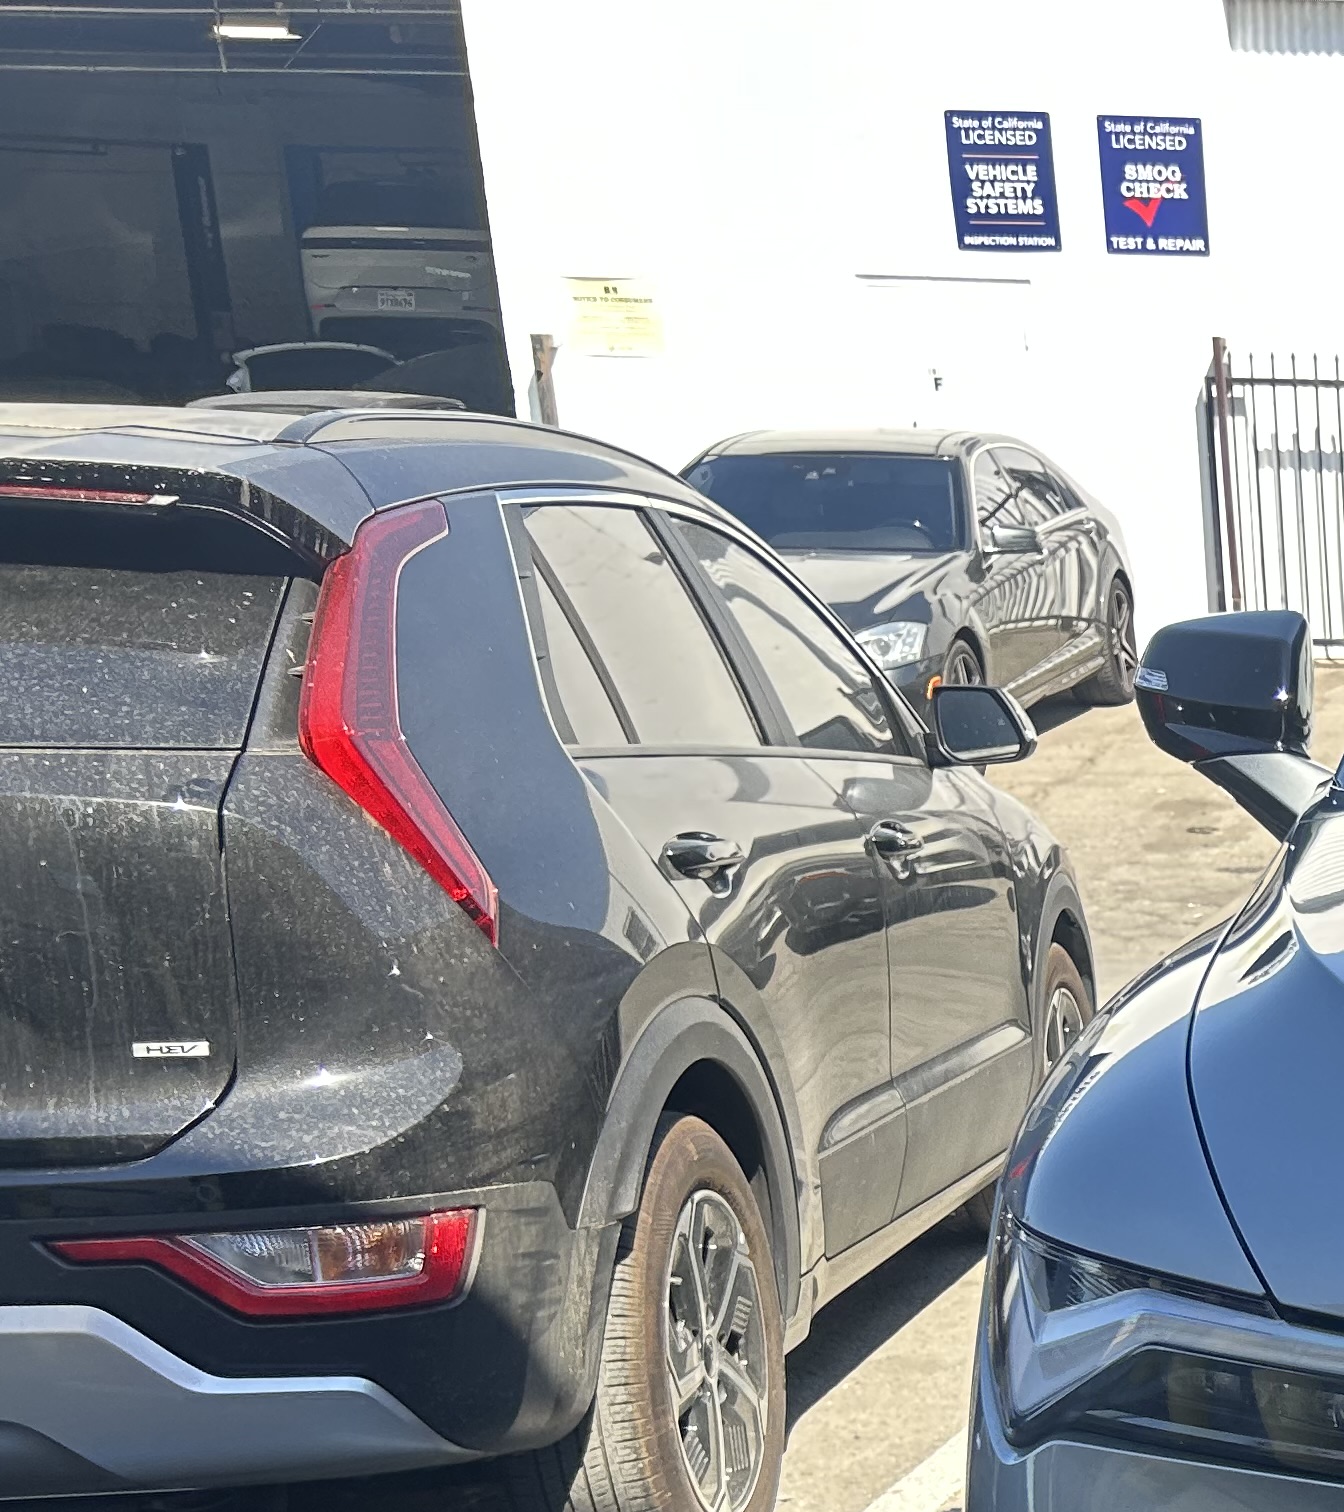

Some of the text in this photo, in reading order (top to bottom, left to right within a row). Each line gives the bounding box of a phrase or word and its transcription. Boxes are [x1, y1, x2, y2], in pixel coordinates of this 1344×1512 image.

[951, 116, 1043, 129] State of California
[1104, 121, 1195, 135] State of California
[960, 130, 1037, 145] LICENSED
[1111, 134, 1187, 150] LICENSED
[964, 163, 1038, 181] VEHICLE
[1124, 164, 1182, 181] SMOG
[971, 181, 1035, 198] SAFETY
[1120, 181, 1189, 199] CHECK
[966, 198, 1044, 214] SYSTEMS
[1018, 236, 1056, 247] STATION
[1110, 236, 1206, 251] TEST & REPAIR
